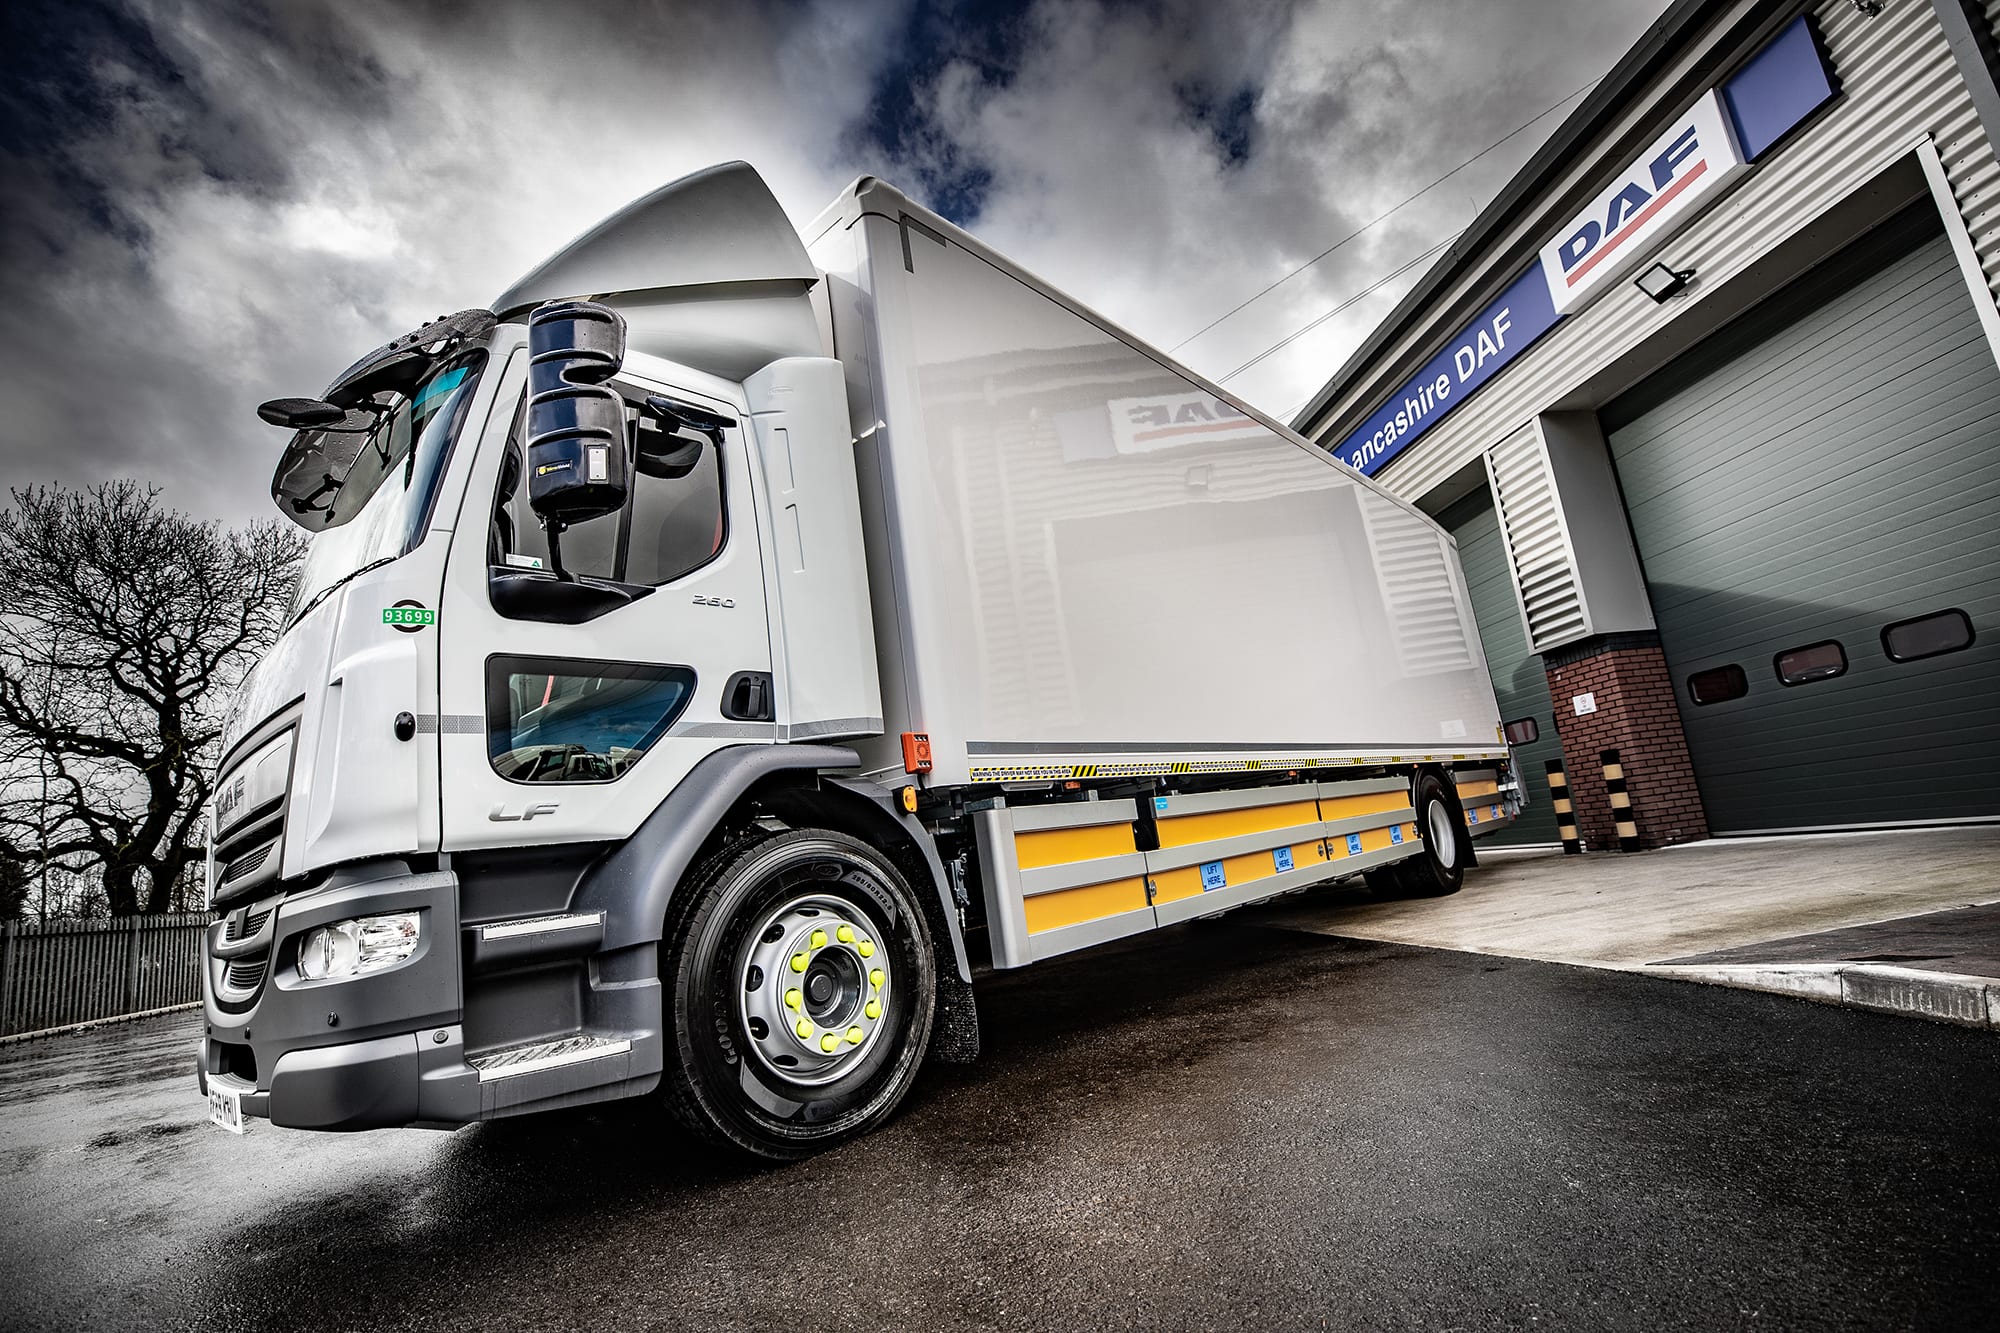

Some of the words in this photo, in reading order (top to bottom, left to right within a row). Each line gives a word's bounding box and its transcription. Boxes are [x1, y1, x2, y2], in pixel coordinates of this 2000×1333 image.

[1558, 124, 1700, 273] DAF
[1340, 373, 1451, 472] ancashire
[1454, 307, 1512, 384] DAF
[692, 594, 736, 609] 260
[384, 610, 432, 623] 93699
[488, 801, 560, 821] LF
[1277, 850, 1287, 859] LIFT
[1279, 858, 1290, 868] HERE
[1206, 865, 1218, 875] LIFT
[1207, 875, 1221, 885] HERE
